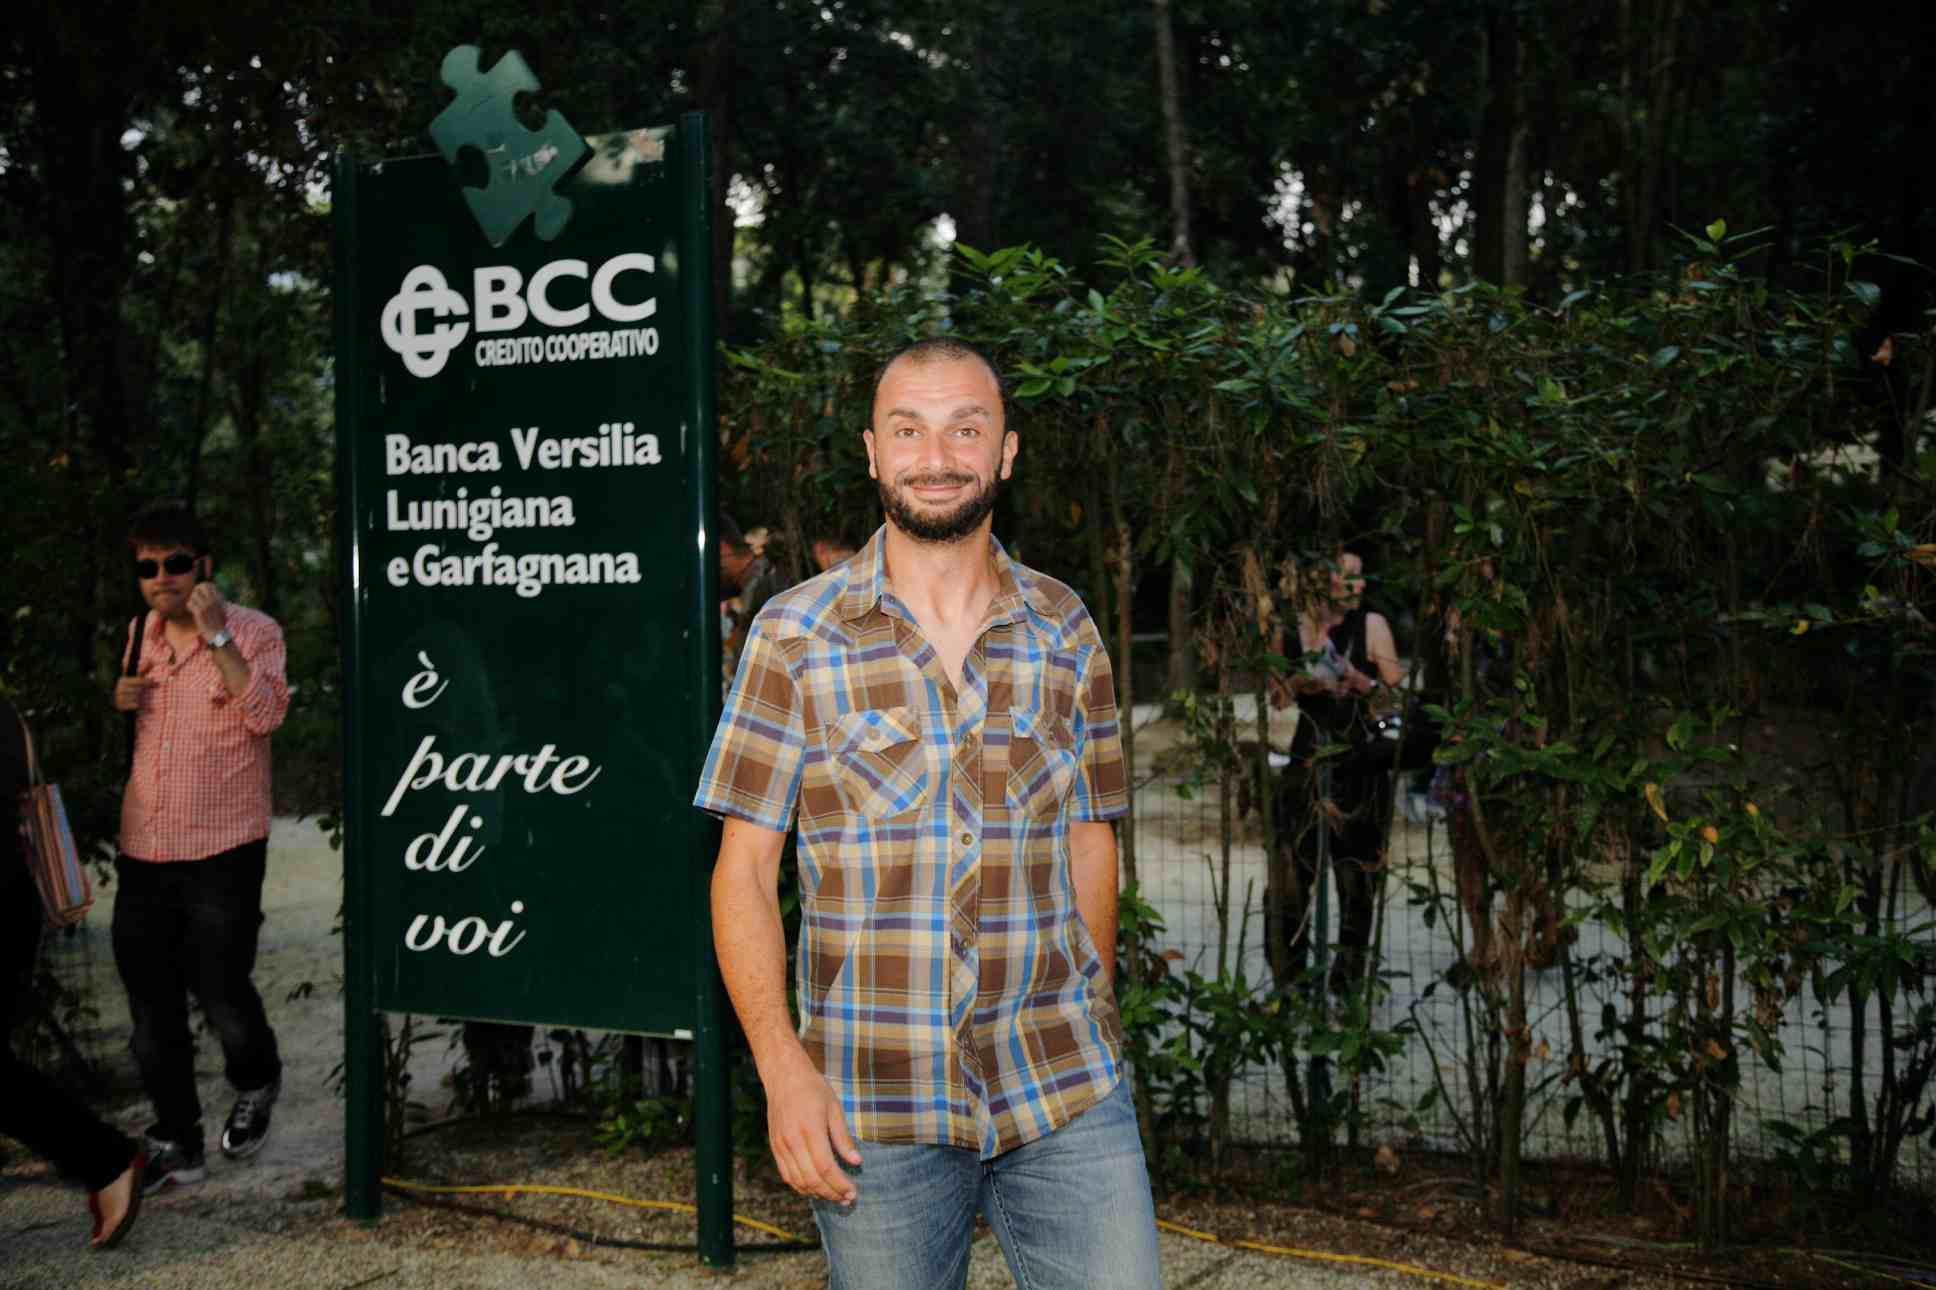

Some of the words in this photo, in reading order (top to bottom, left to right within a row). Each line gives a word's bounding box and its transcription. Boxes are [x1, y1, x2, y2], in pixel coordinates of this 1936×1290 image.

[473, 253, 657, 332] BCC
[475, 334, 544, 367] CREDITO
[545, 328, 659, 362] COOPERATIVO
[385, 434, 502, 475] Banca
[510, 422, 662, 470] Versilia
[386, 485, 576, 542] Lunigiana
[413, 543, 642, 598] Garfagnana
[401, 650, 449, 709] è
[380, 735, 602, 817] parte
[404, 804, 485, 873] di
[404, 900, 526, 957] voi
